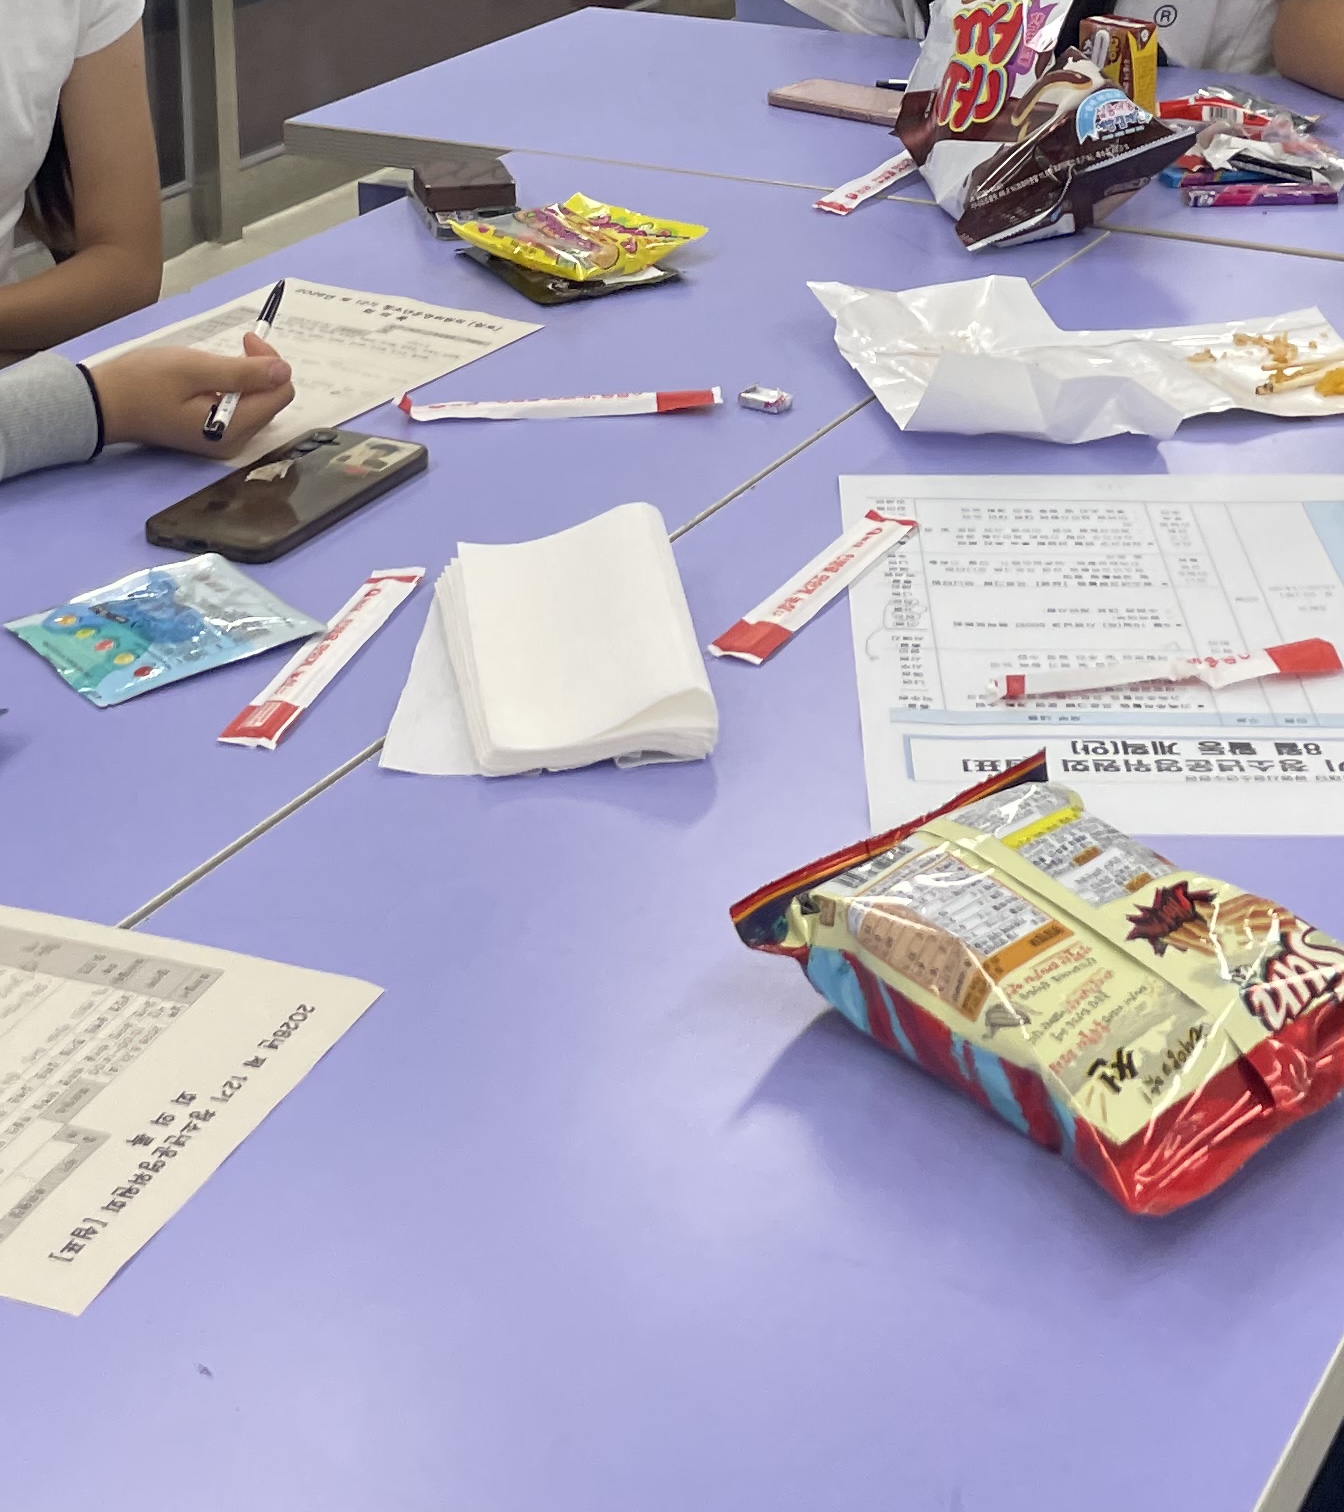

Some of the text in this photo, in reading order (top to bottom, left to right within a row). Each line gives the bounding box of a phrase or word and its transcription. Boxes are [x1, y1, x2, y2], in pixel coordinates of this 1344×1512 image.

[1273, 741, 1322, 756] 8월
[1061, 758, 1308, 773] 청소년운영위원회
[210, 1075, 248, 1103] 12기
[99, 1108, 217, 1213] 청소년운영위원회
